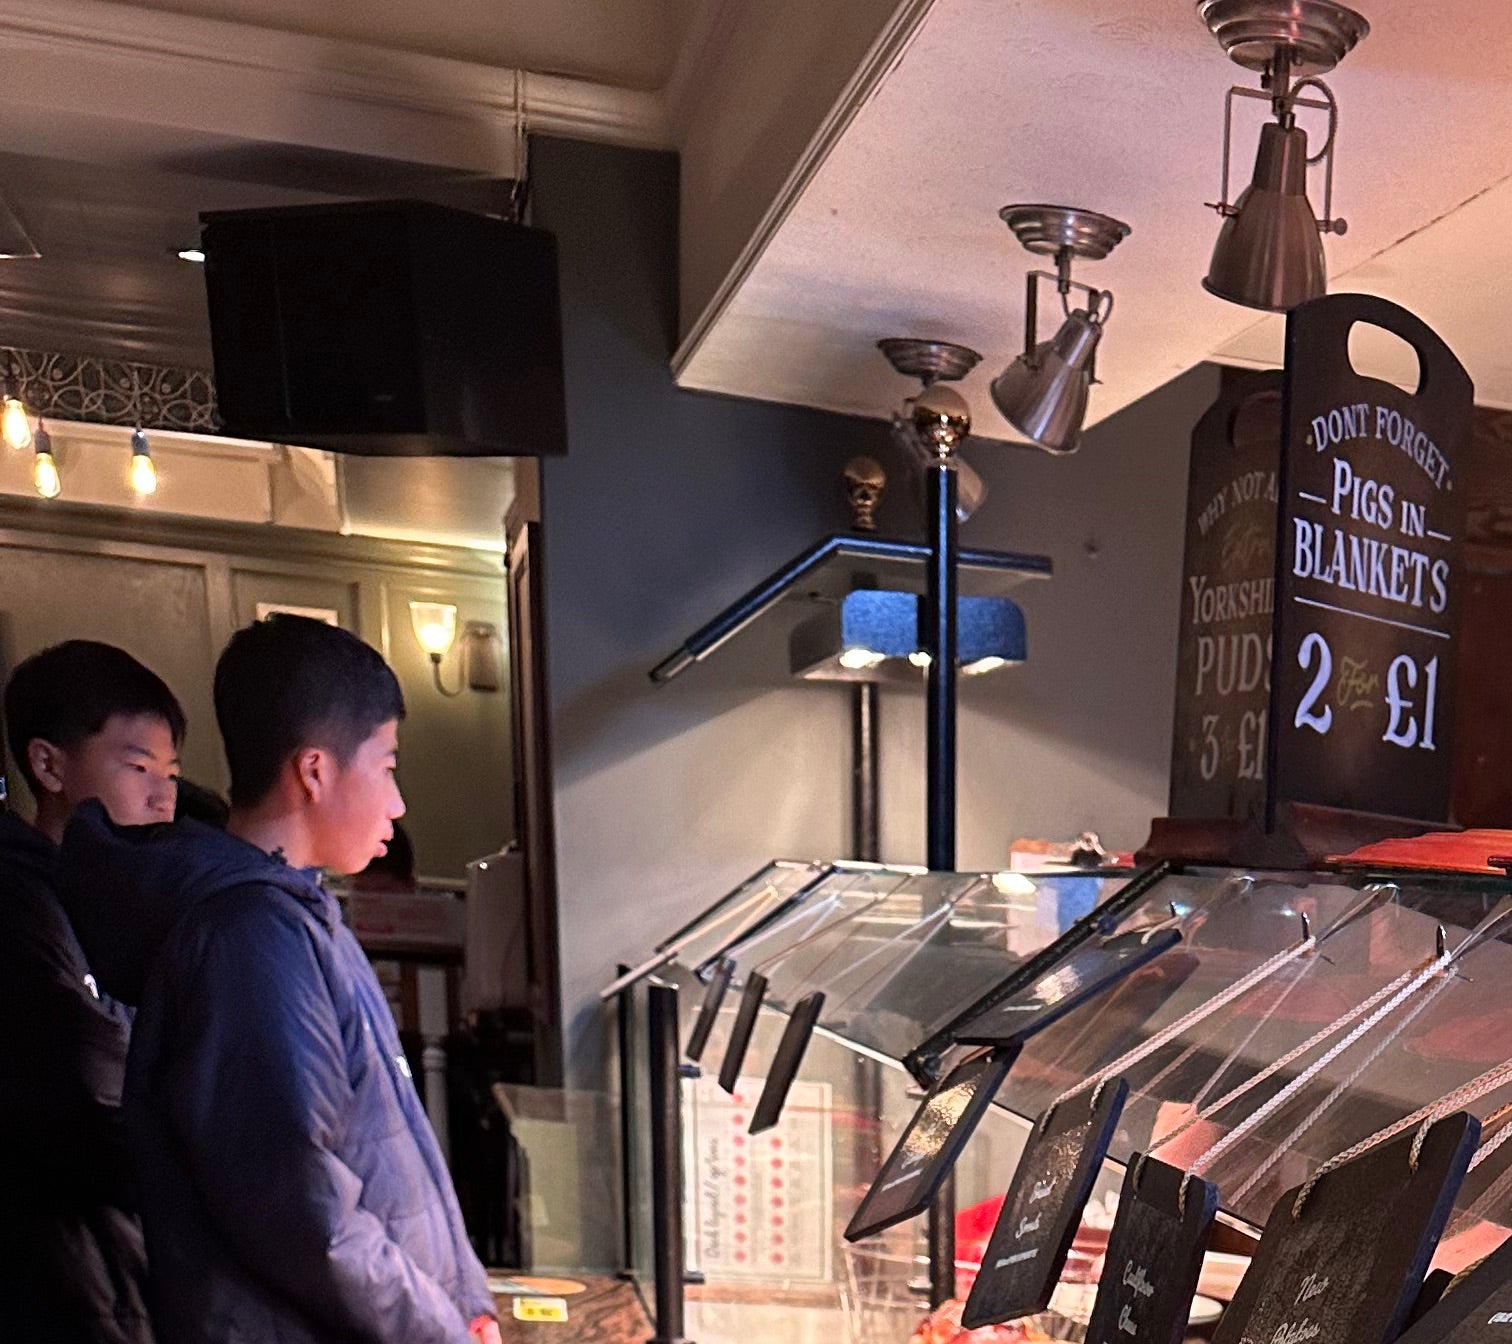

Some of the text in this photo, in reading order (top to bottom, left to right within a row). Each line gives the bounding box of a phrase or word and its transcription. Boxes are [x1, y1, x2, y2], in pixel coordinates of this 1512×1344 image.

[1311, 403, 1450, 489] DONT FORGET
[1331, 457, 1426, 538] PIGS IN
[1292, 517, 1450, 614] BLANKETS
[1294, 632, 1332, 734] 2
[1382, 654, 1439, 751] £1
[1200, 713, 1220, 780] 3
[1236, 707, 1267, 780] £1
